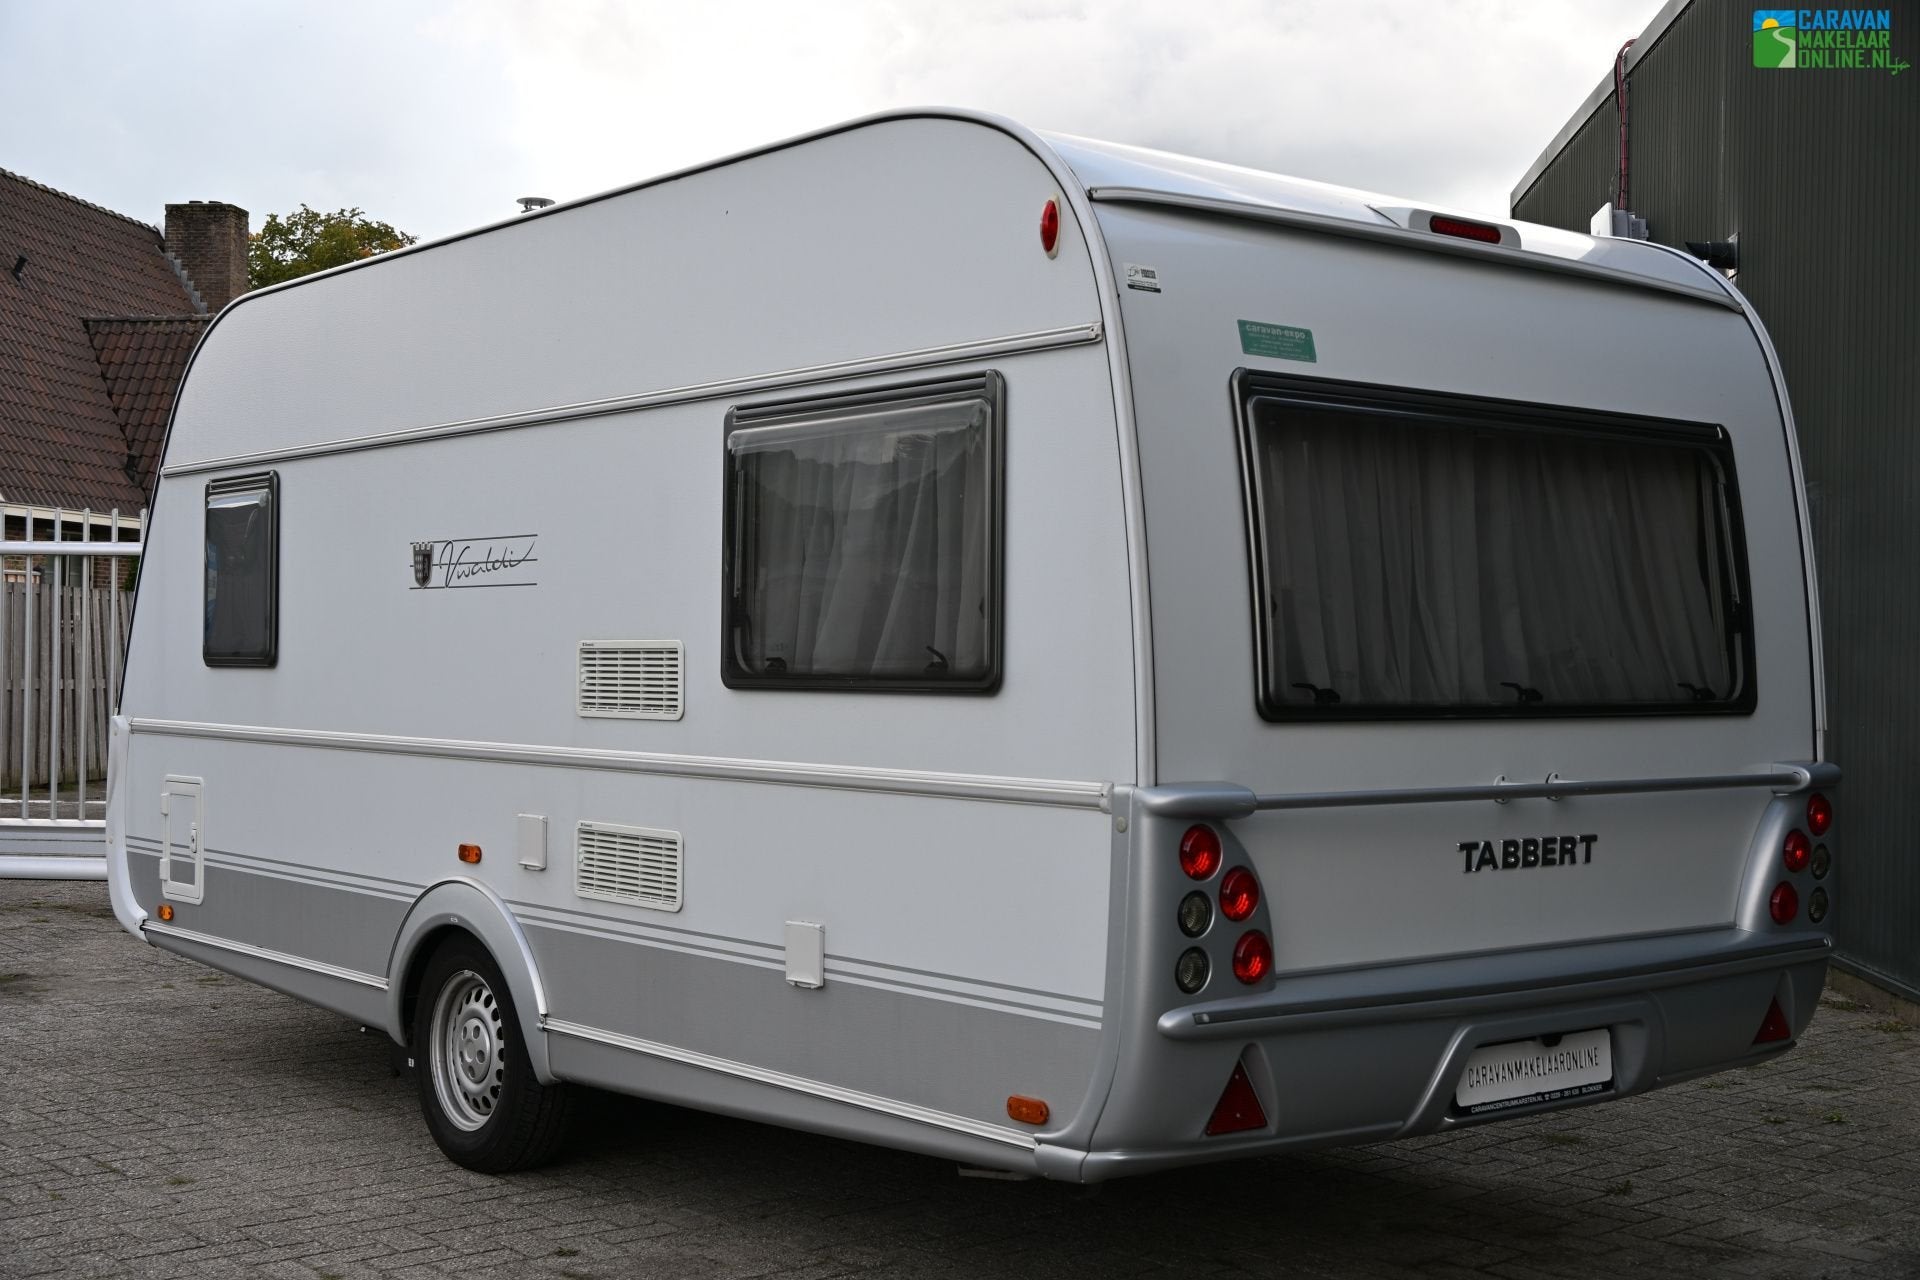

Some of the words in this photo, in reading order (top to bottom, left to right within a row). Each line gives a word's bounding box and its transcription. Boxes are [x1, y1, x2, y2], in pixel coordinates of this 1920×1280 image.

[1456, 834, 1598, 873] TABBERT
[1468, 1047, 1599, 1088] CARAVANMAKELAARONLINE
[1582, 1084, 1603, 1094] BLOKKER
